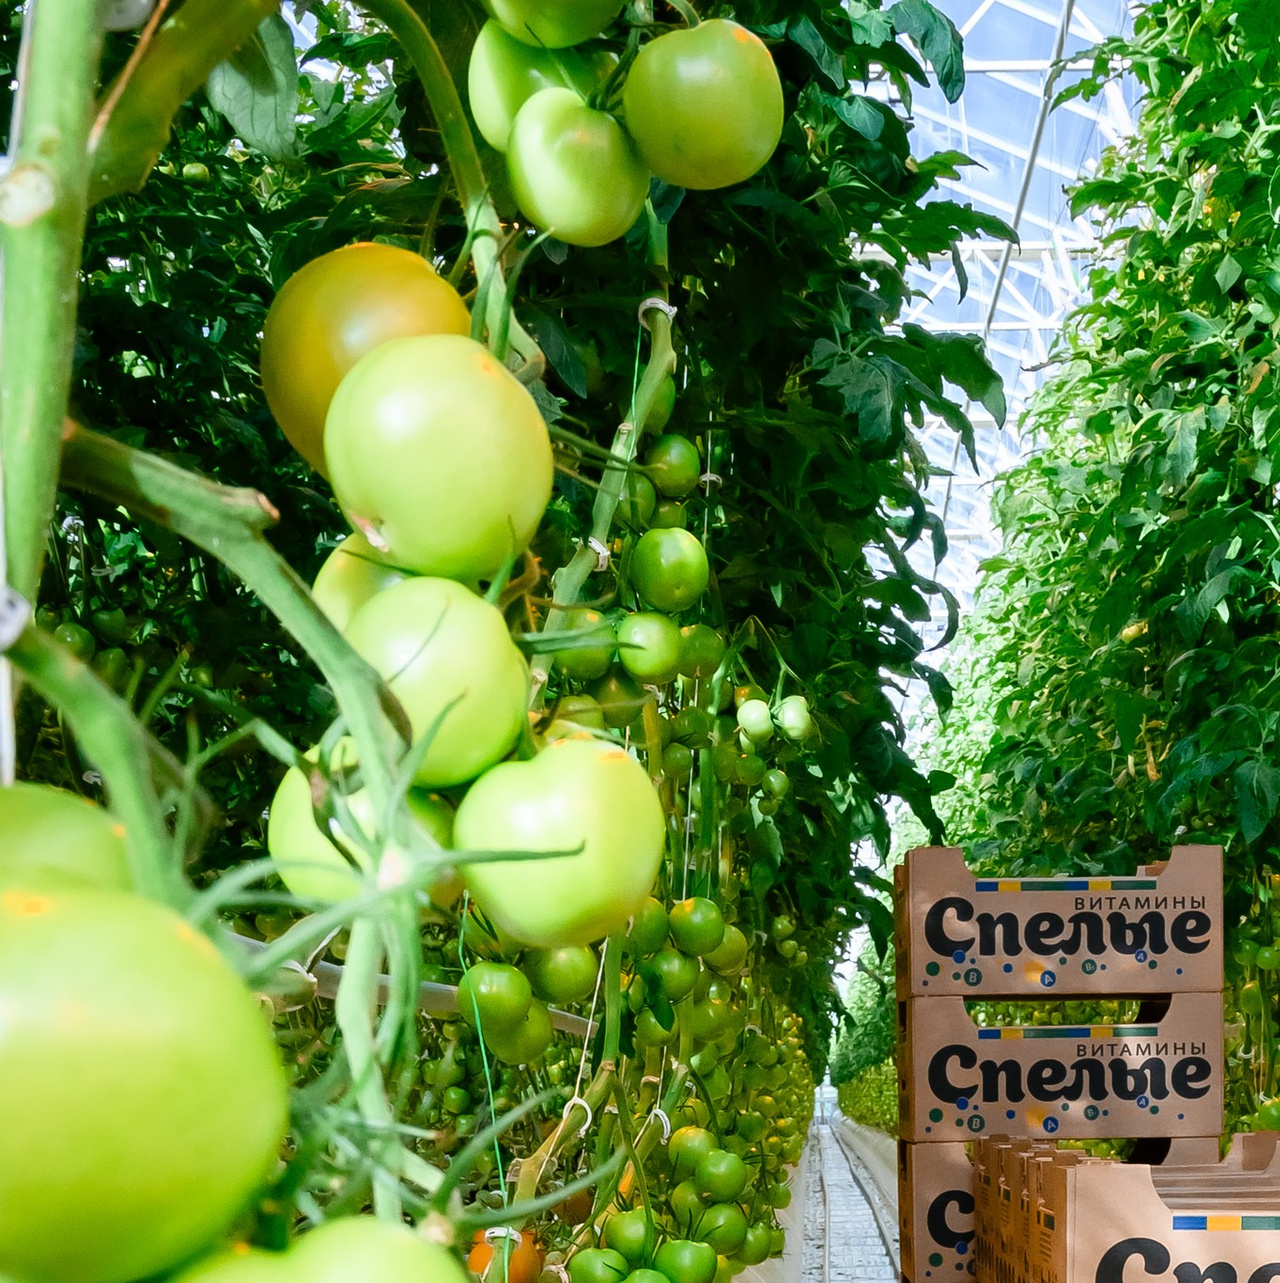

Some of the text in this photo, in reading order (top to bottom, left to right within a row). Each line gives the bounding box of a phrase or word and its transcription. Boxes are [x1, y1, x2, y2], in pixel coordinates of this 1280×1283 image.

[1074, 896, 1206, 911] ВИТАМИНЫ
[924, 896, 1212, 957] Спелые
[1076, 1042, 1207, 1057] ВИТАМИНЫ
[927, 1044, 1212, 1104] Спелые
